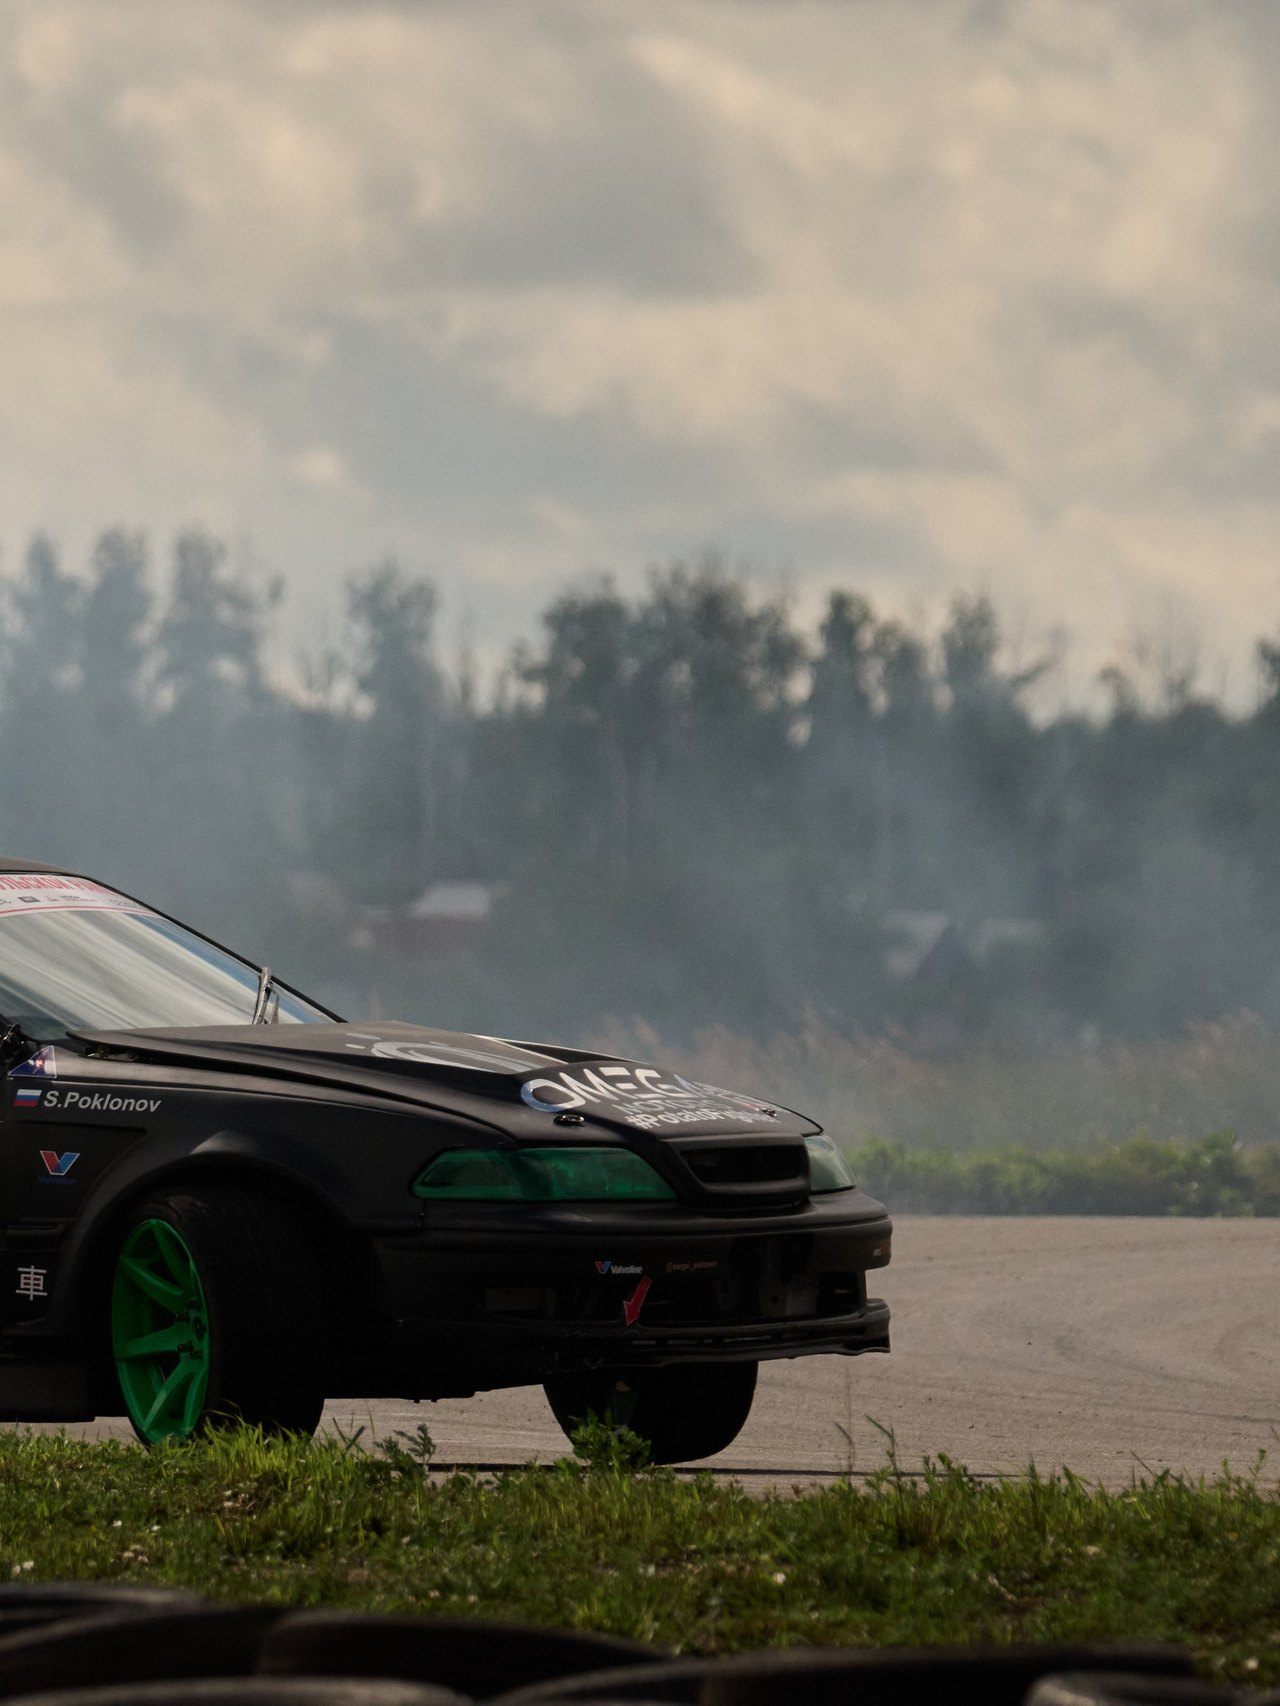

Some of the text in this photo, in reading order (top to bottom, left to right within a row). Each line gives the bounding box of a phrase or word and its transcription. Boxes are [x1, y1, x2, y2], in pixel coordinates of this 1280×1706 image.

[43, 1090, 161, 1112] S.Poklonov
[520, 1066, 710, 1112] OMEGA
[15, 1265, 49, 1301] 車
[610, 1264, 643, 1275] Valvoline
